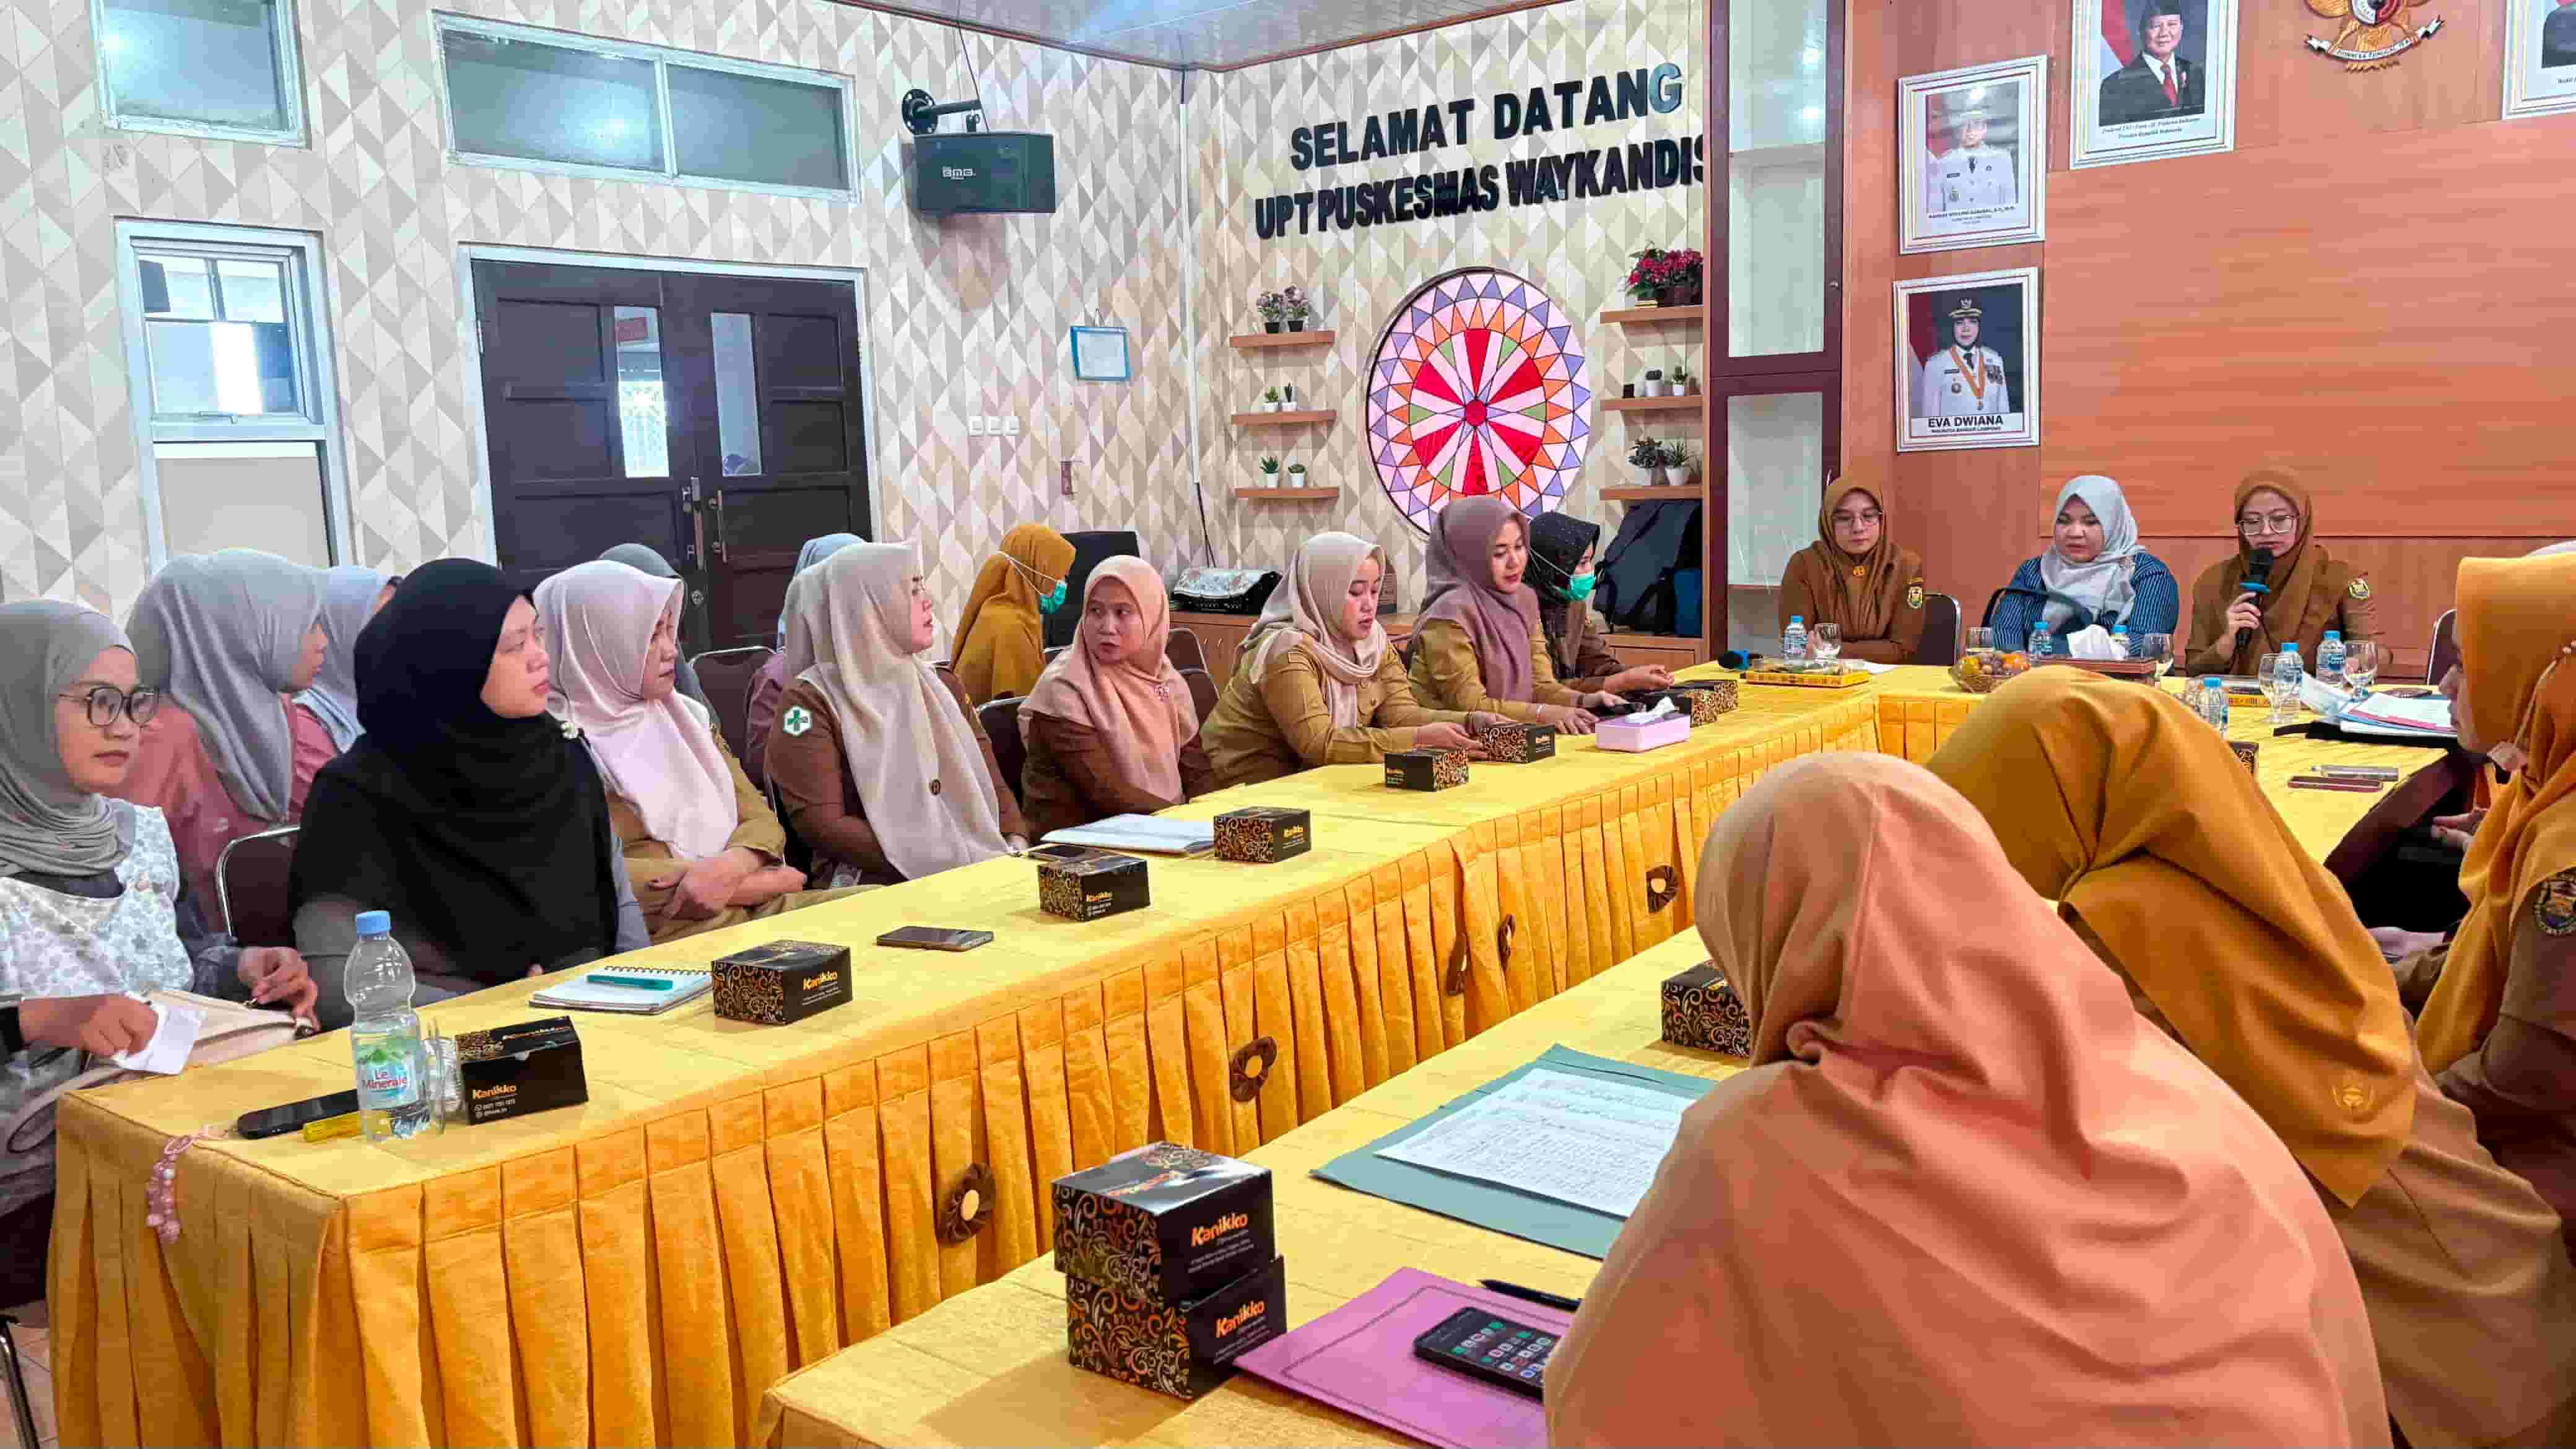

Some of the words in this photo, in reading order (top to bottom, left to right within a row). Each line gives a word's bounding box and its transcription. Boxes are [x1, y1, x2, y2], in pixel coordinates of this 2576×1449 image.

[1289, 98, 1475, 170] SELAMAT
[1494, 63, 1683, 140] DATANG
[1255, 191, 1313, 239] UPT
[1317, 165, 1499, 232] PUSKESMAS
[1928, 418, 1951, 428] EVA
[1954, 416, 2003, 427] DWIANA
[363, 1076, 407, 1090] Minerale
[375, 1070, 387, 1080] Le
[472, 1085, 516, 1099] Kanikko
[1191, 1212, 1249, 1248] Kanikko
[1216, 1300, 1265, 1338] Kanikko
